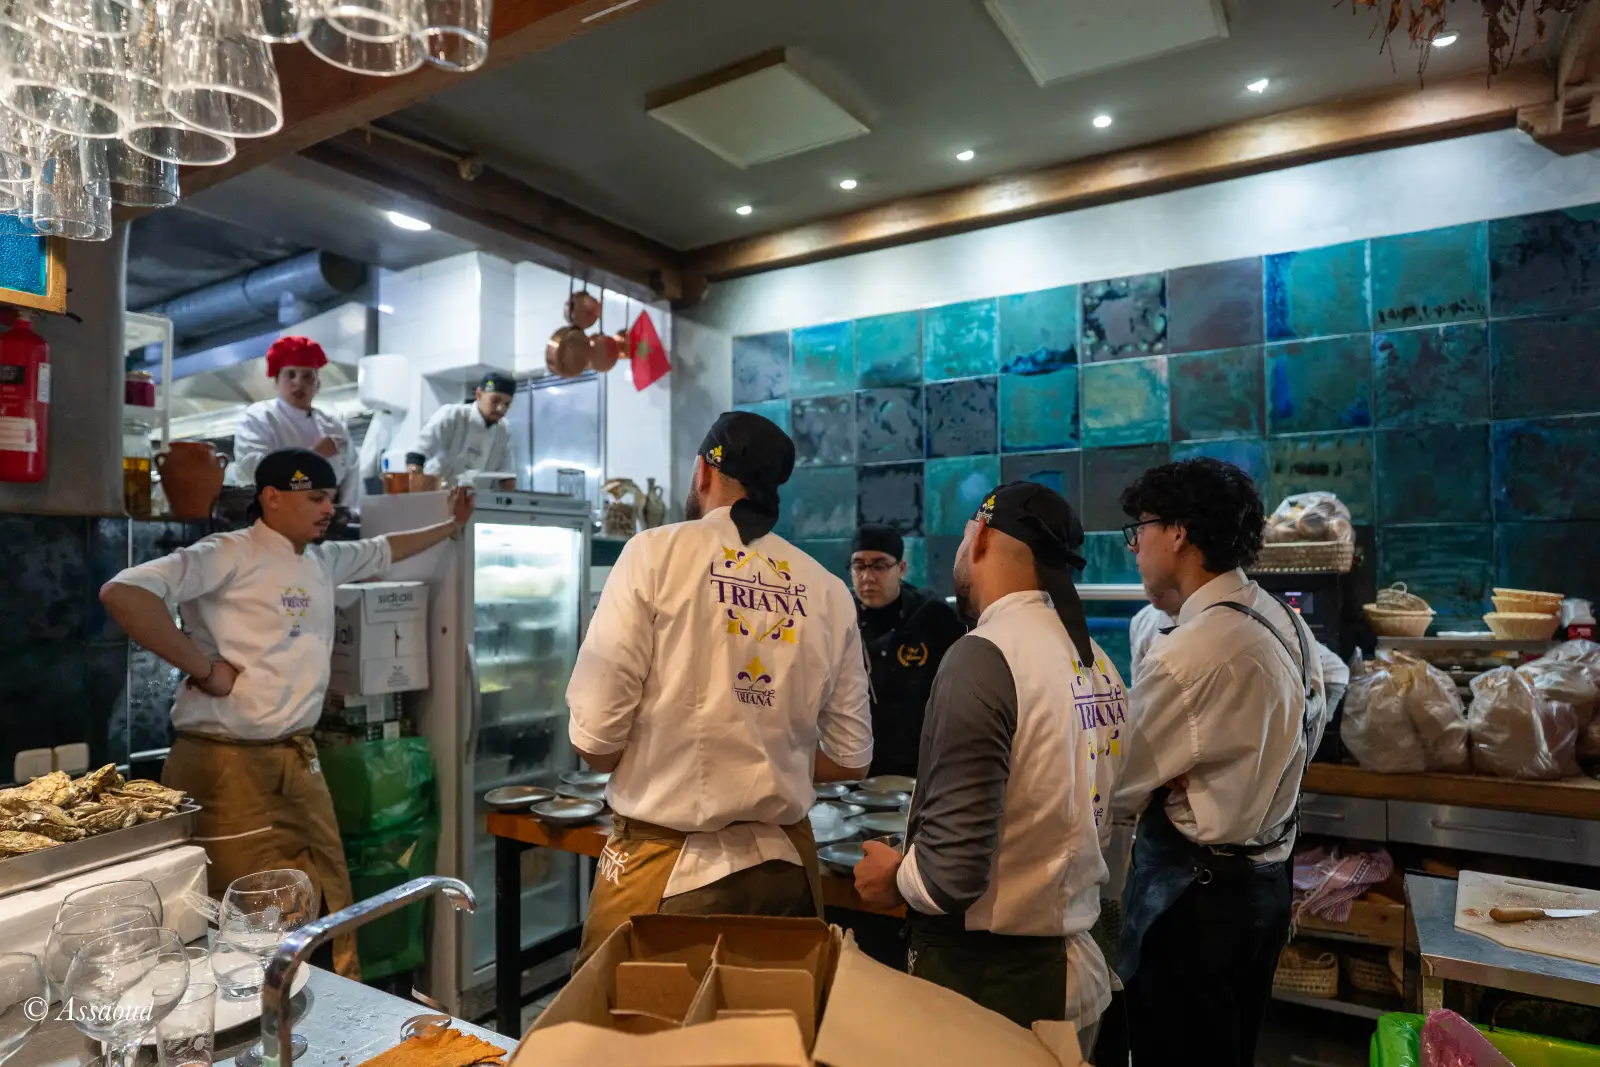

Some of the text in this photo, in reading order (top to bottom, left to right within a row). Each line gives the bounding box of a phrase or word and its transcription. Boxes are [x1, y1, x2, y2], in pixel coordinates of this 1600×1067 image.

[711, 580, 808, 618] TRIANA
[734, 689, 776, 707] TRIANA
[1074, 698, 1126, 731] TRIANA
